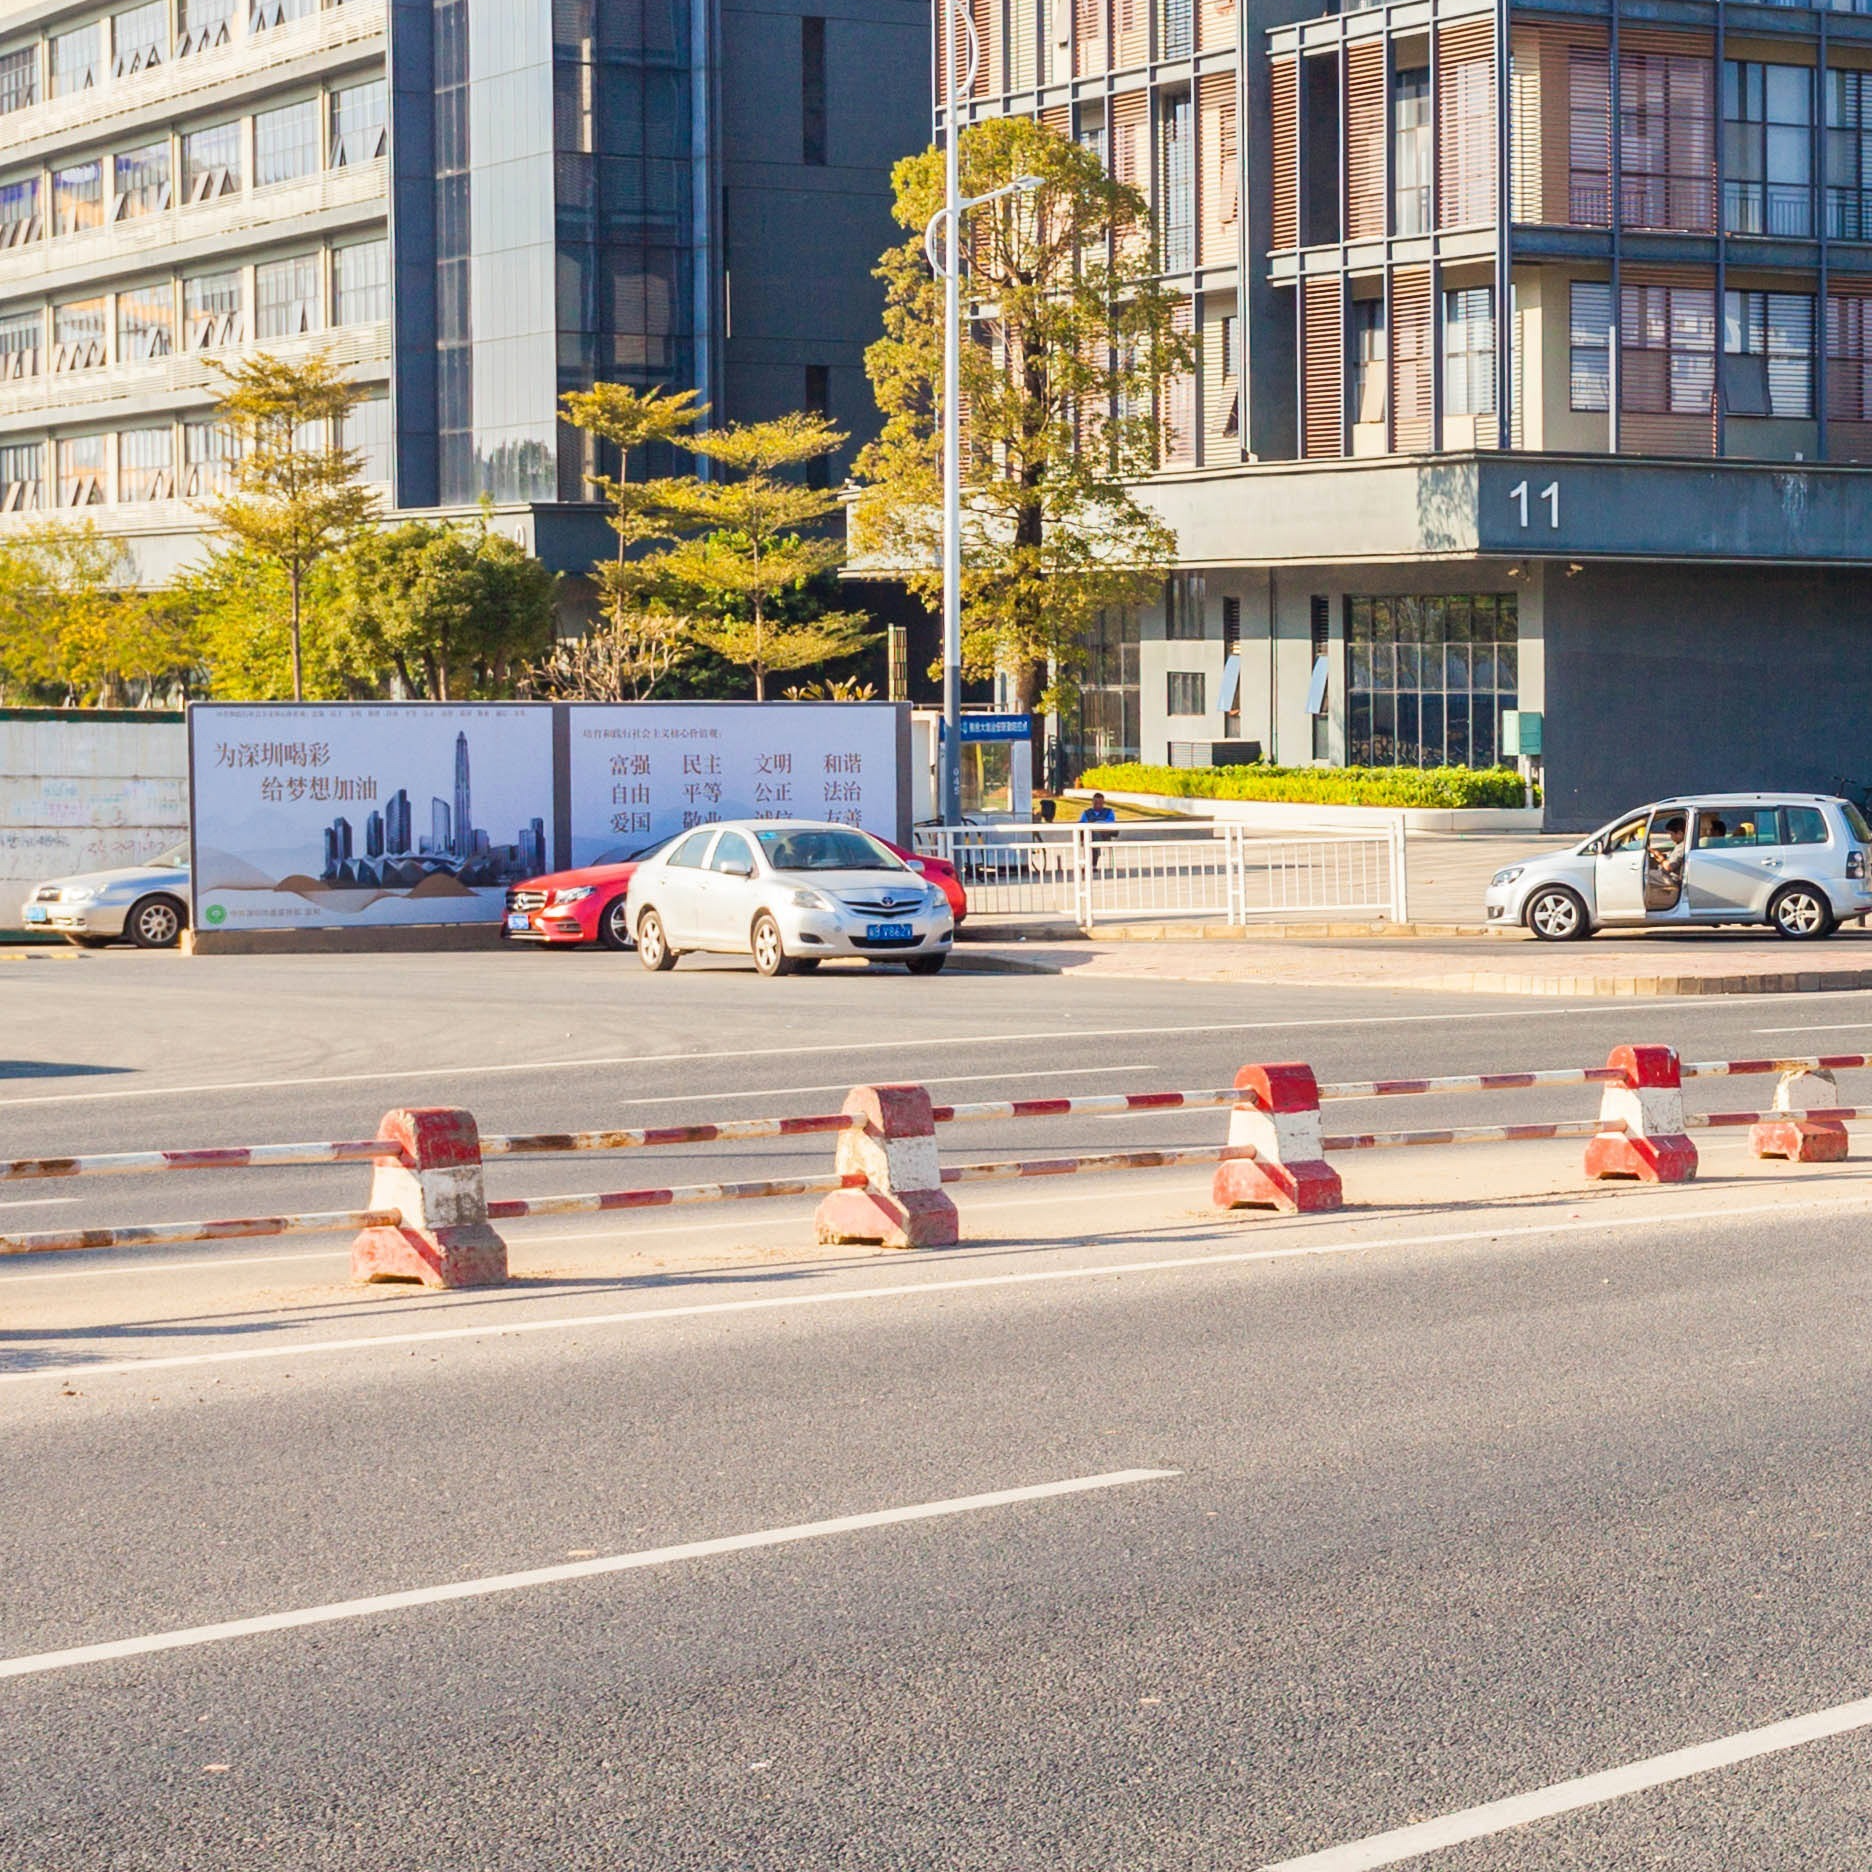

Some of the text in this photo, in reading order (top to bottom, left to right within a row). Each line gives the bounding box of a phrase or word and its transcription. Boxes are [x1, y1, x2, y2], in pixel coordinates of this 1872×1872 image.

[1509, 480, 1559, 529] 11
[215, 741, 331, 769] 为深圳喝彩
[609, 752, 862, 776] 富强 民主 文明 和谐
[261, 775, 378, 803] 给梦想加油
[611, 780, 862, 806] 自由 平等 公正 法治
[610, 811, 651, 834] 爱国
